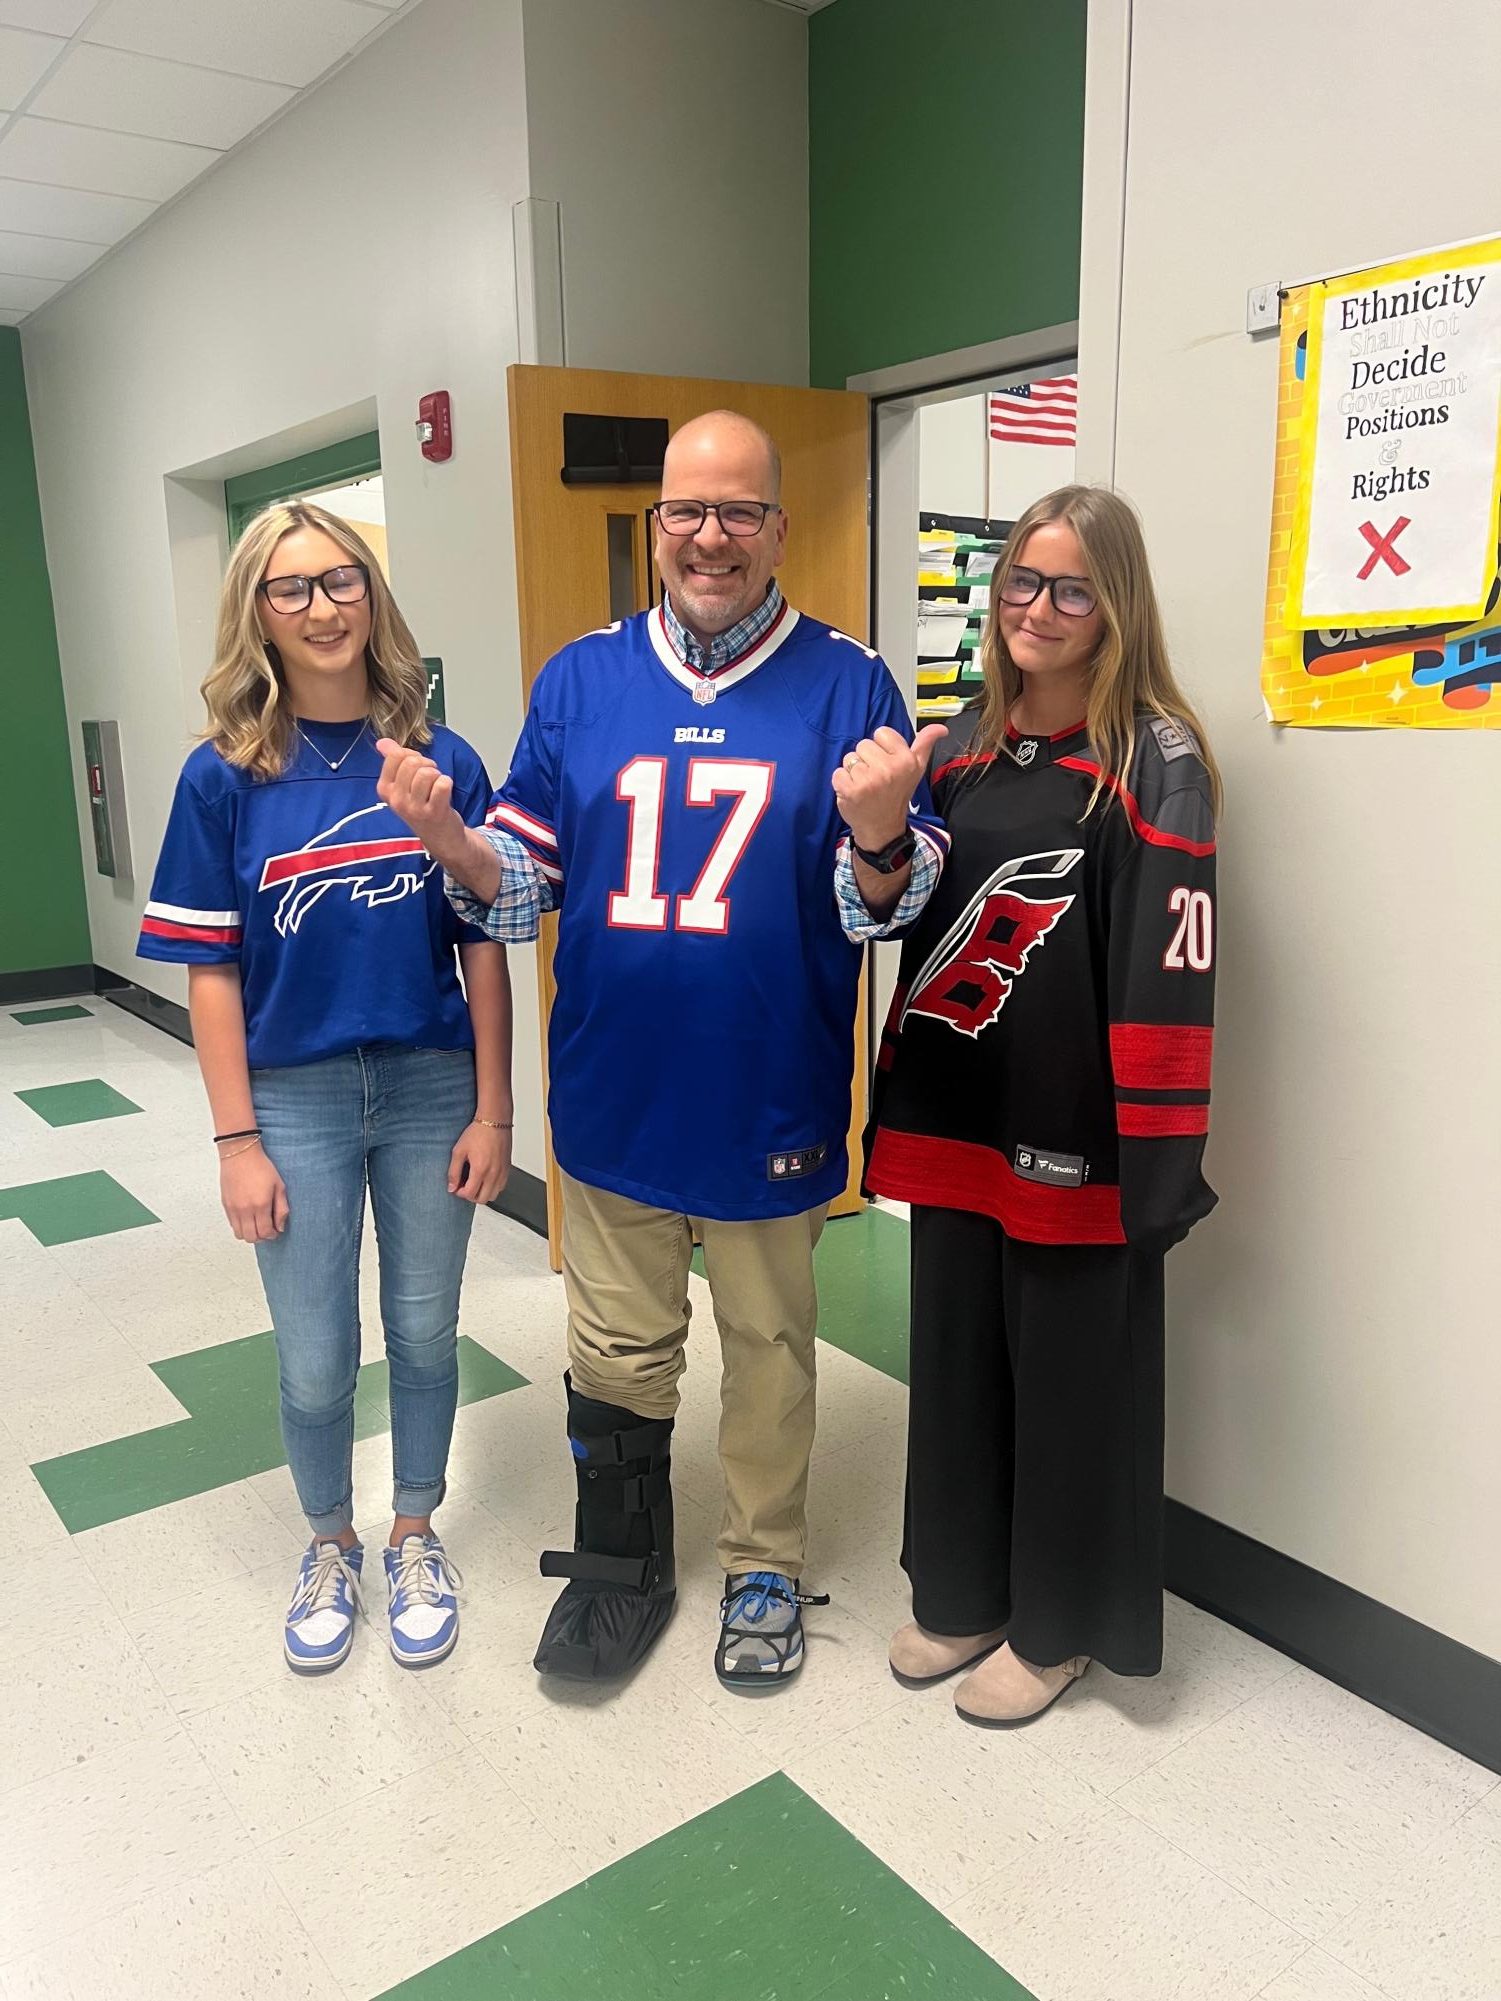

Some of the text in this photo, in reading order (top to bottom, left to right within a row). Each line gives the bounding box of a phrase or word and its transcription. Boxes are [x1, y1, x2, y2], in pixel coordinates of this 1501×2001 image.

[1340, 273, 1486, 330] Ethnicity
[1350, 312, 1460, 357] Shall Not
[1351, 345, 1447, 390] Decide
[1346, 404, 1449, 439] Positions
[1378, 438, 1402, 466] &
[1351, 466, 1430, 501] Rights
[695, 688, 714, 700] NFL
[674, 727, 726, 744] BILLS
[607, 754, 777, 935] 17
[1163, 885, 1214, 972] 20
[1048, 1162, 1079, 1175] Fanatics
